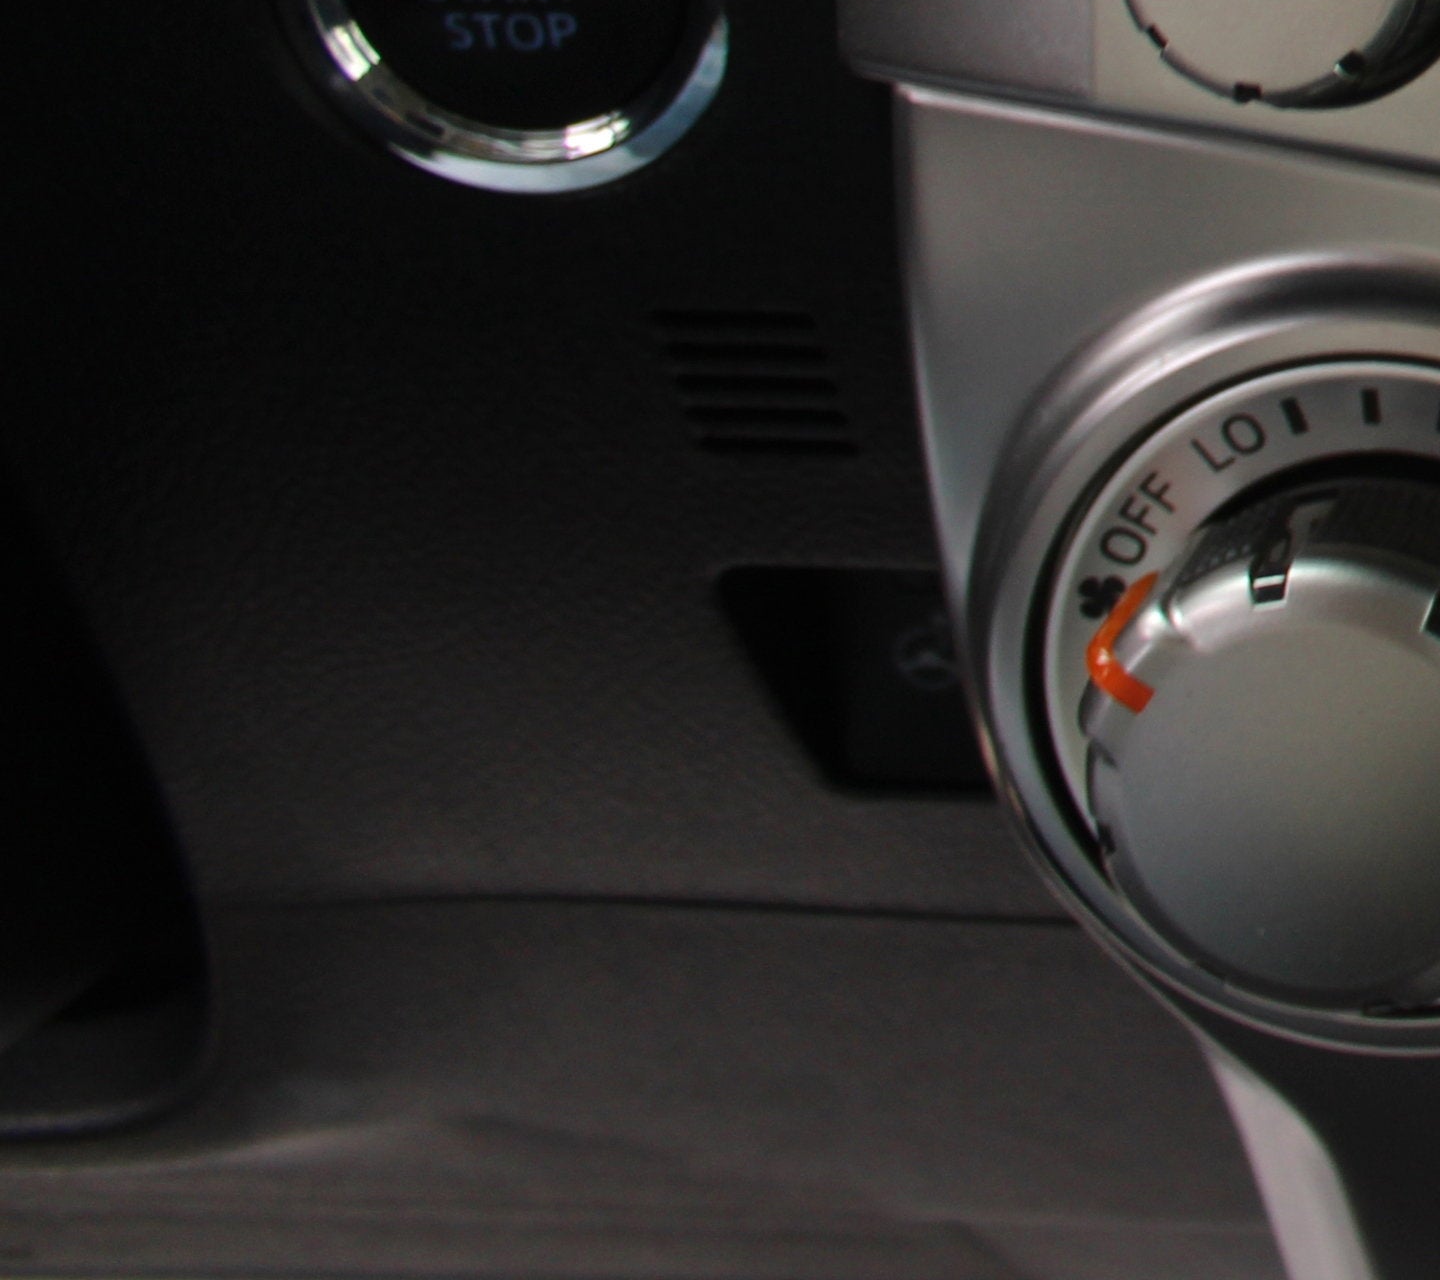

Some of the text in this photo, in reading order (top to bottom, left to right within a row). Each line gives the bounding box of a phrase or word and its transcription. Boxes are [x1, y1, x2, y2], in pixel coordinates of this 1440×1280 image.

[446, 11, 578, 51] STOP
[1191, 413, 1266, 474] LO
[1101, 472, 1178, 567] OFF
